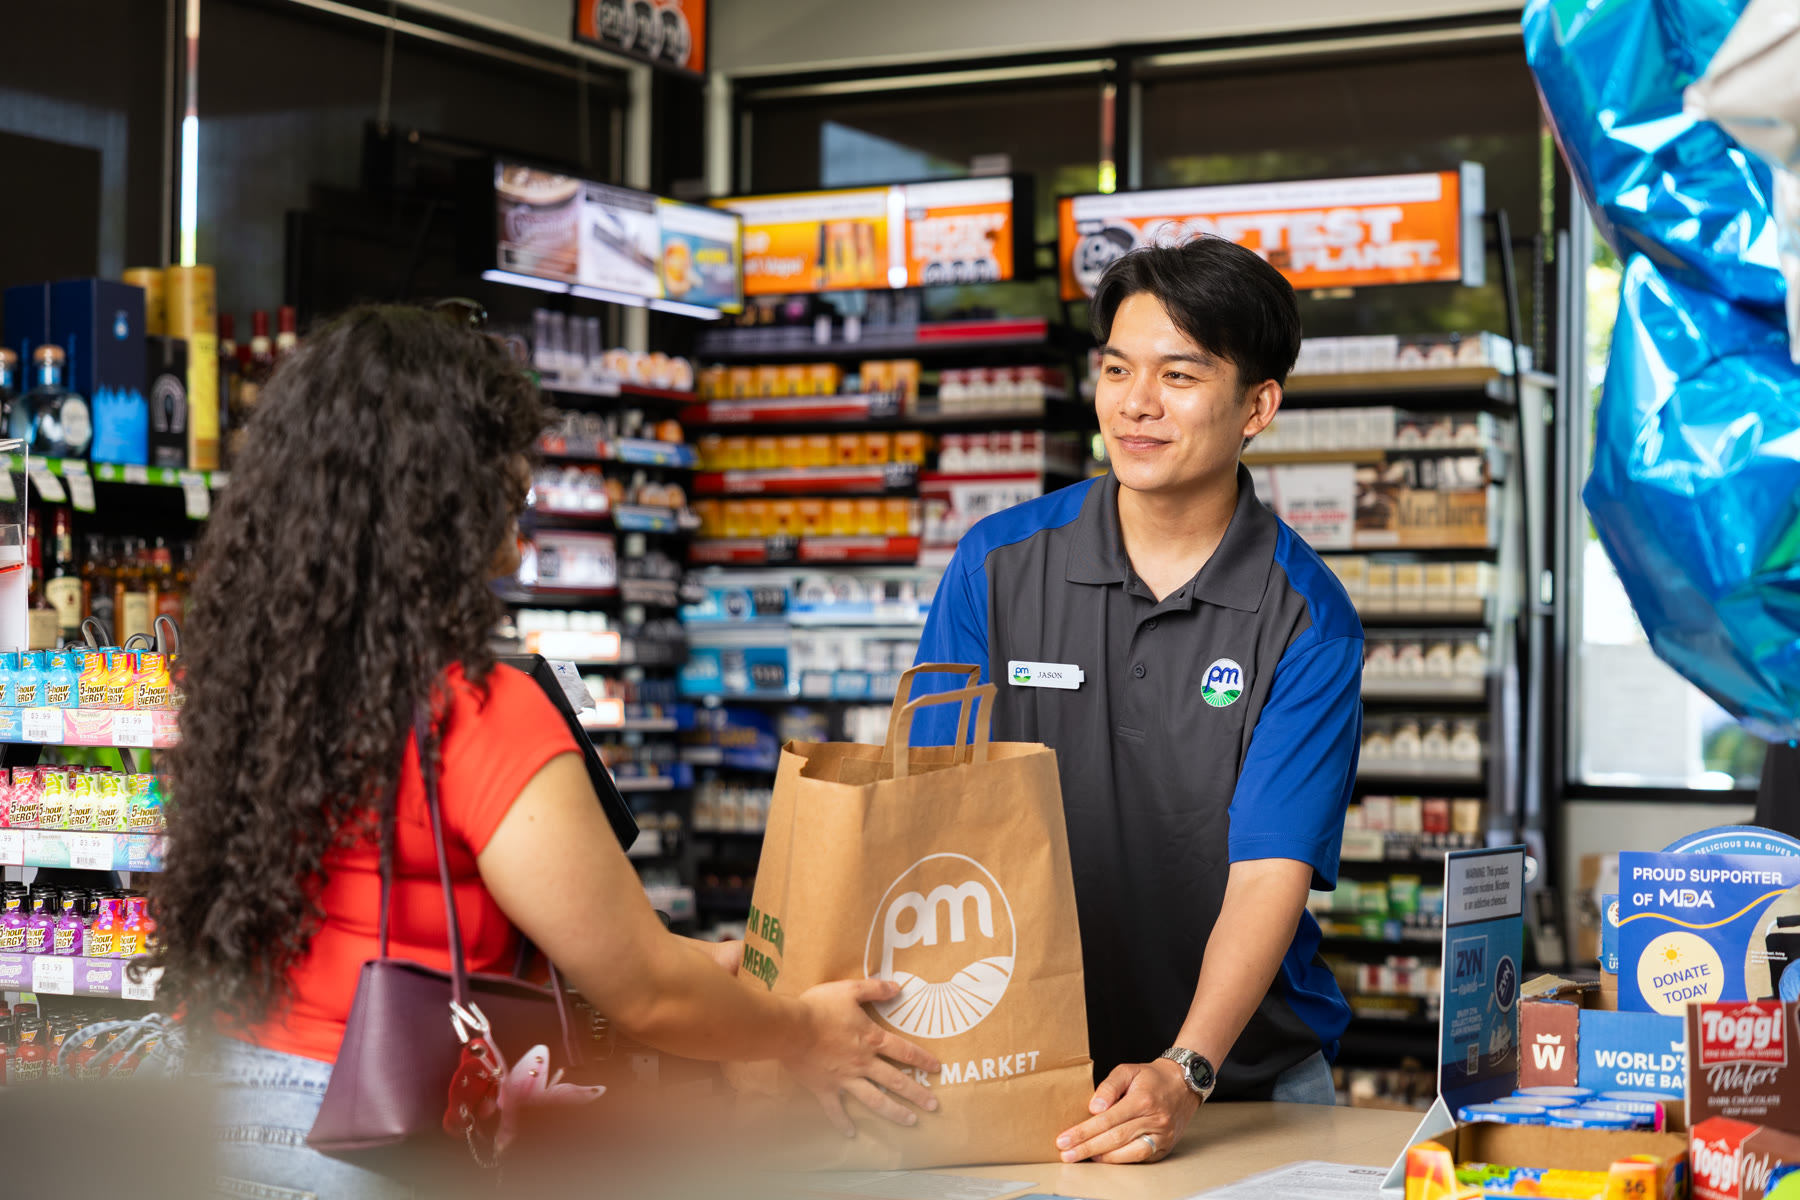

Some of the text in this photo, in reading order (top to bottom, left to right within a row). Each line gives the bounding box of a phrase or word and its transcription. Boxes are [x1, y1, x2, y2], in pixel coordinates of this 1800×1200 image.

[80, 682, 105, 695] 5-hour
[139, 683, 167, 696] 5-hour
[1204, 666, 1239, 693] pm
[79, 692, 105, 704] ENERGY
[138, 694, 166, 706] ENERGY
[10, 812, 36, 823] ENERGY
[11, 801, 37, 814] 5-hour
[1744, 840, 1762, 849] BAR
[1765, 843, 1792, 857] GIVES
[1633, 867, 1782, 885] PROUD SUPPORTER
[1632, 888, 1715, 908] OF MDA
[880, 880, 994, 980] pm
[1456, 947, 1483, 978] ZYN
[1498, 964, 1511, 997] ZYN
[1653, 963, 1711, 989] DONATE
[1663, 982, 1709, 1004] TODAY
[1703, 1007, 1783, 1050] Toggi
[16, 1057, 43, 1071] 5-hour
[1532, 1043, 1566, 1071] W
[940, 1050, 1040, 1086] MARKET
[1706, 1062, 1779, 1095] Wafers
[1616, 1071, 1655, 1087] GIVE
[1692, 1138, 1740, 1192] Toggi
